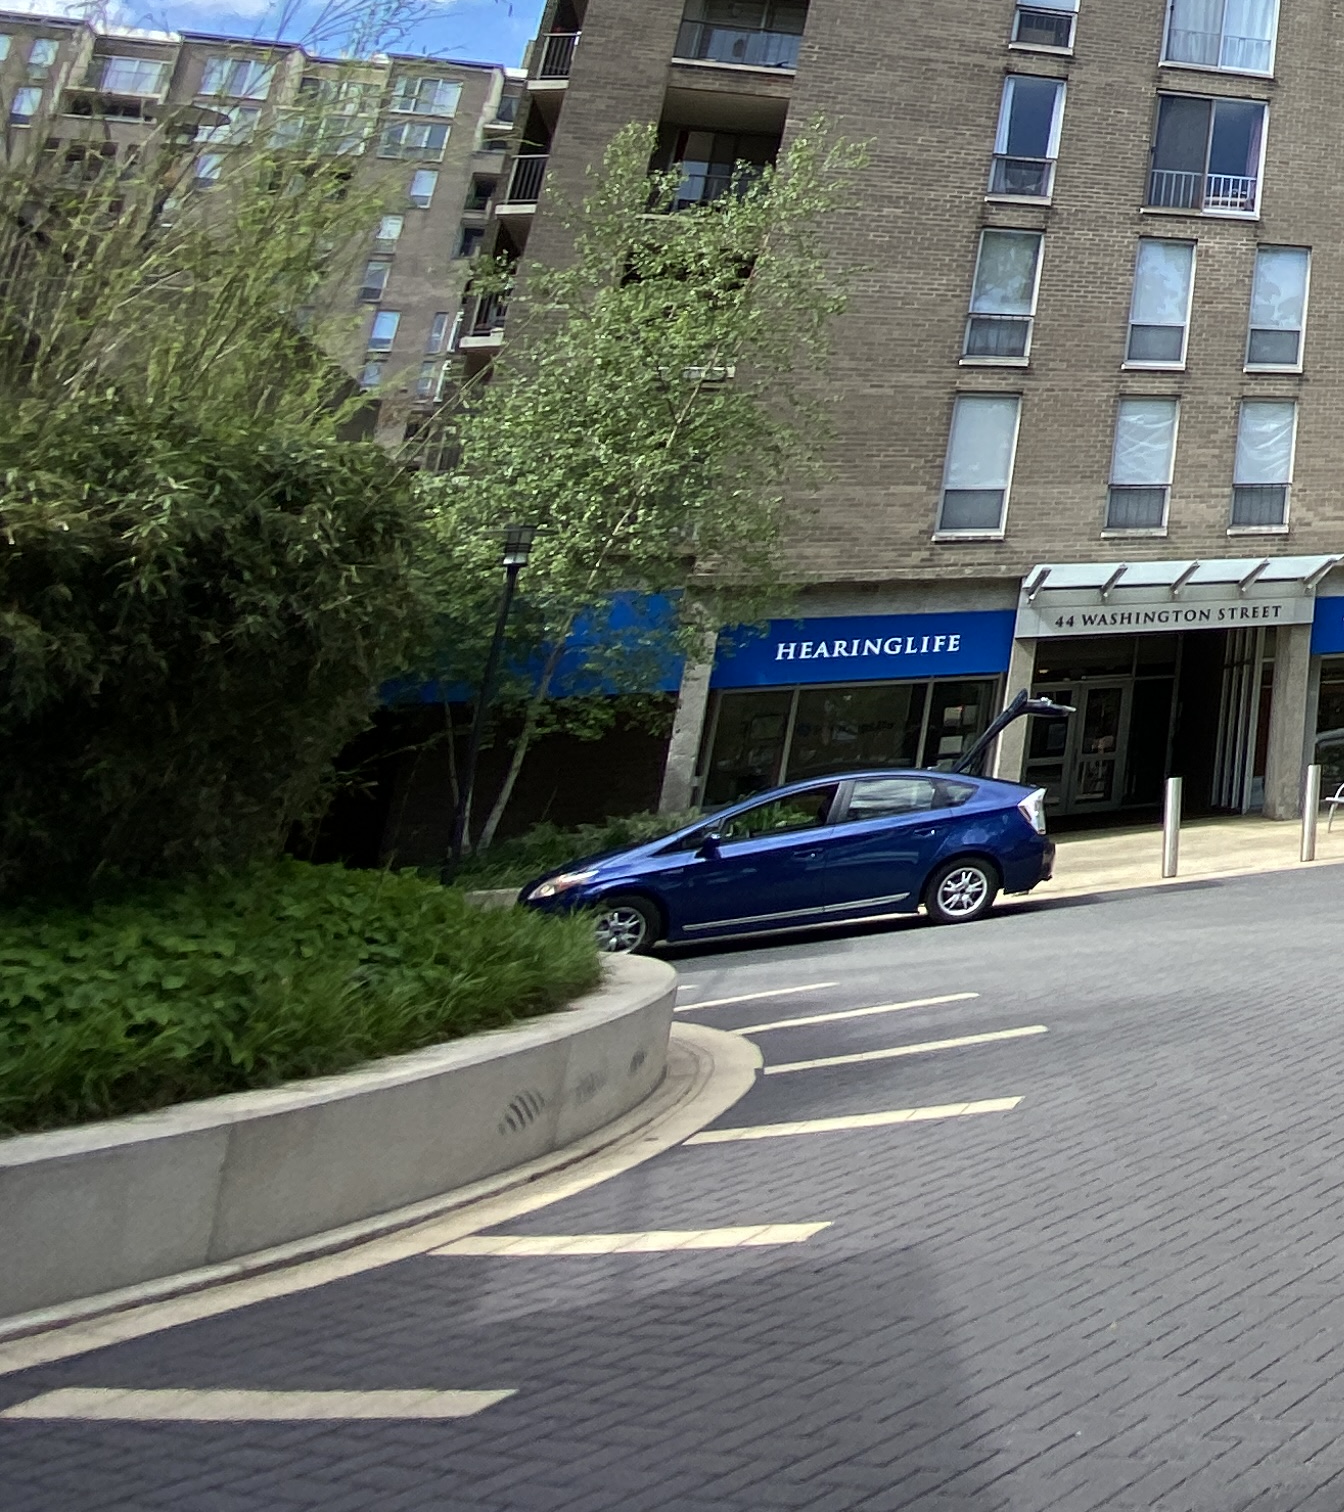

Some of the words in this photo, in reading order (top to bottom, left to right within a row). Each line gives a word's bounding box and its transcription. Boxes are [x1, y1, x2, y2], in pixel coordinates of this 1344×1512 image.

[1055, 615, 1075, 628] 44
[1081, 607, 1211, 627] WASHINGTON
[1217, 605, 1283, 621] STREET
[775, 634, 961, 661] HEARINGLIFE
